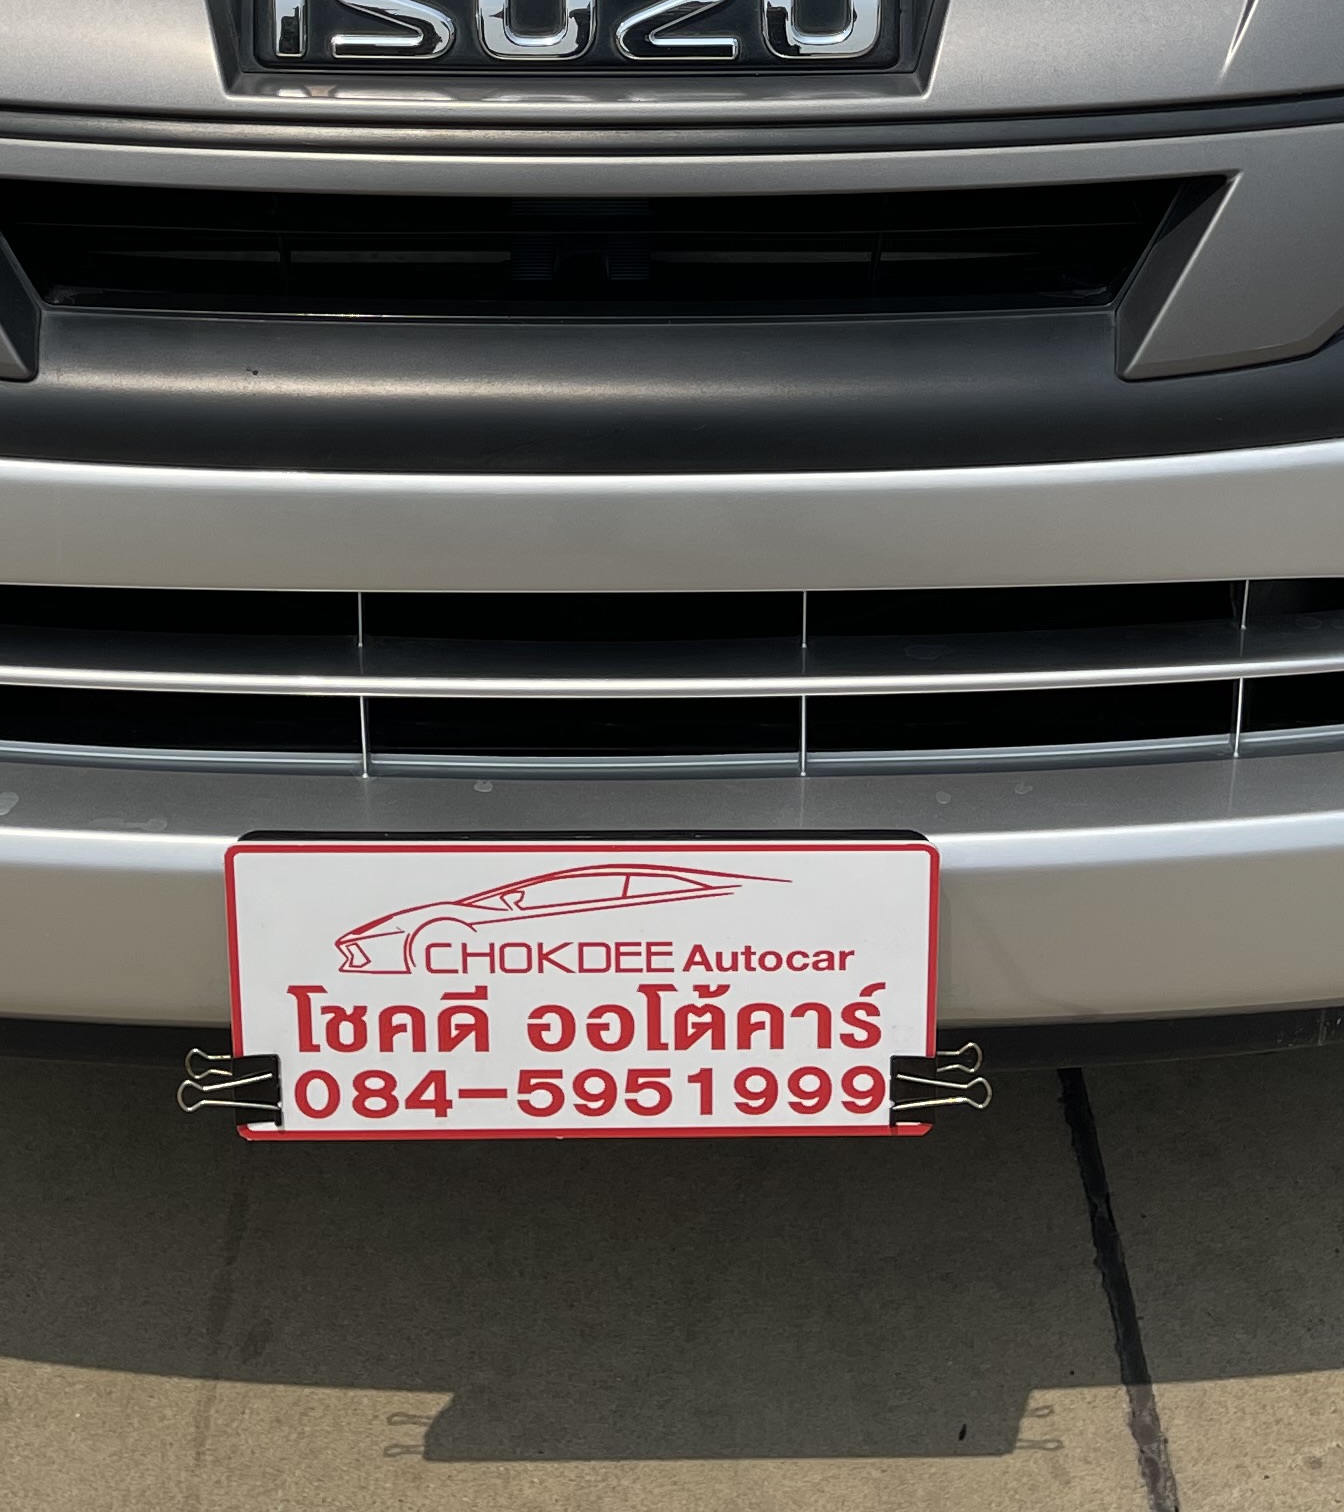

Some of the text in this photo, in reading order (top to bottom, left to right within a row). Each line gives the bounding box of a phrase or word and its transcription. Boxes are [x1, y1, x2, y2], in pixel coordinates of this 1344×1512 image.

[424, 941, 856, 975] CHOKDEE Autocar
[287, 981, 887, 1054] โชคดี ออโต้คาร์
[293, 1065, 887, 1119] 084-5951999
